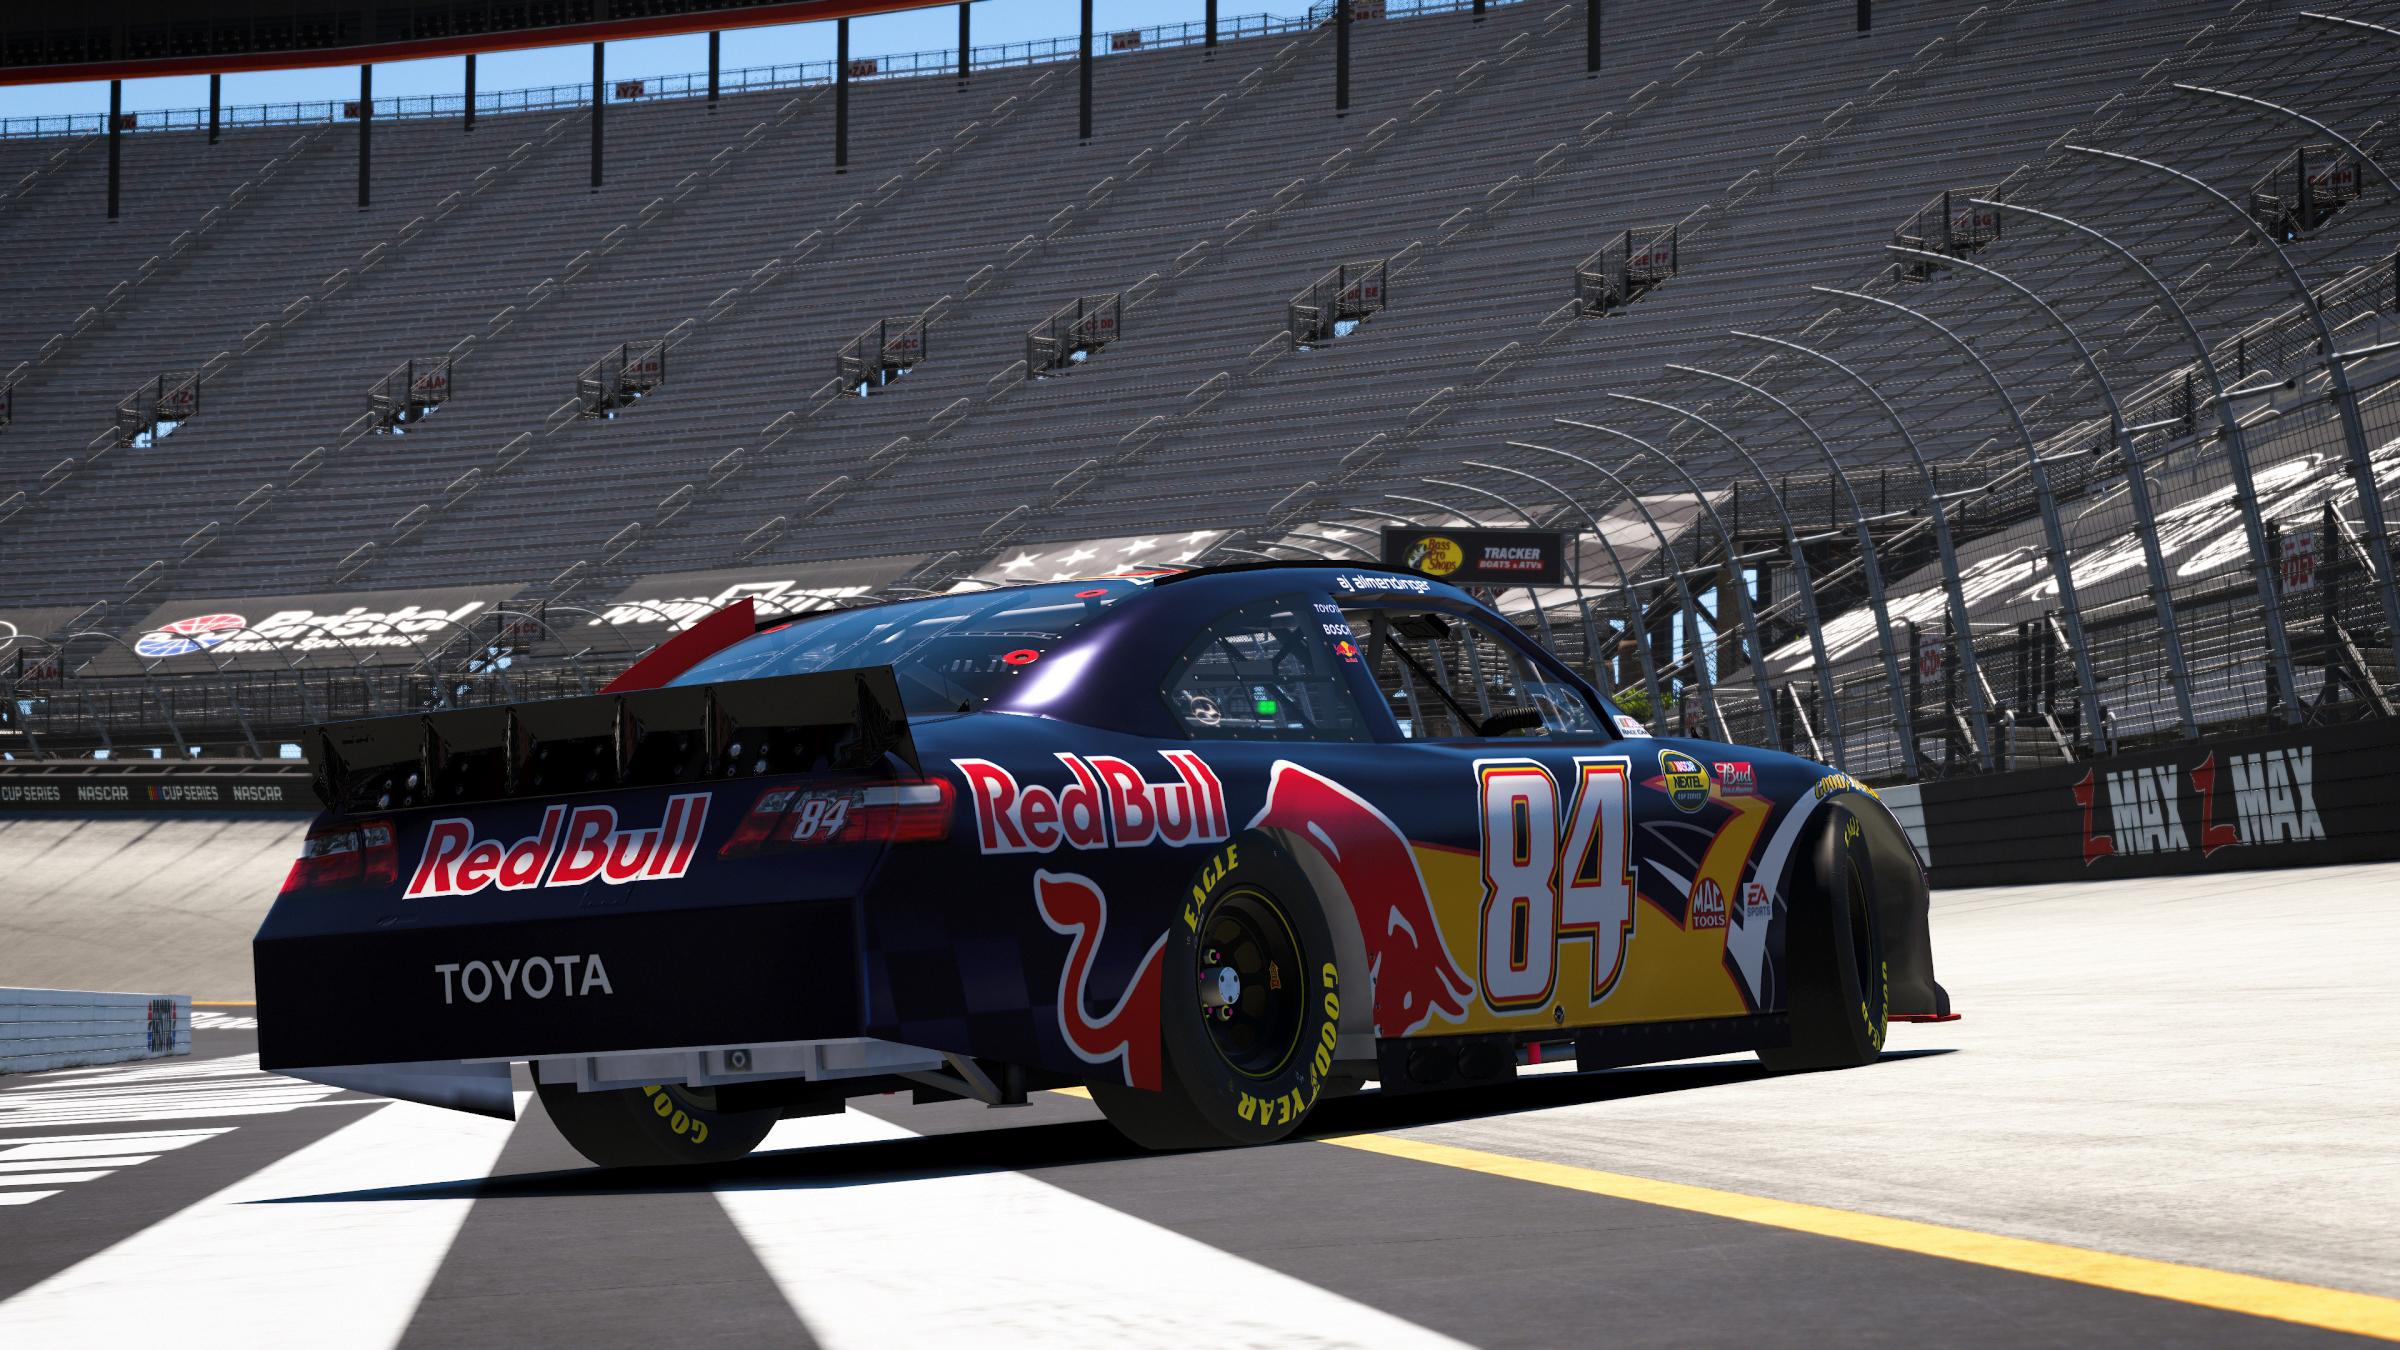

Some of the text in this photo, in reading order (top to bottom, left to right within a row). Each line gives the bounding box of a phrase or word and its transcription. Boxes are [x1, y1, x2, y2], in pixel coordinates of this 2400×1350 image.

[1428, 538, 1450, 550] Bass
[1429, 550, 1446, 560] Pro
[1484, 547, 1541, 559] TRACKER
[1429, 558, 1457, 572] Shops
[1479, 560, 1510, 569] BOATS
[1715, 762, 1751, 786] Bud
[1673, 775, 1704, 789] NEXTEL
[2, 786, 60, 801] CUP SERIES
[78, 786, 128, 801] NASCAR
[162, 786, 218, 801] CUP SERIES
[233, 786, 282, 801] NASCAR
[792, 799, 849, 841] 84
[1184, 844, 1239, 934] EAGLE
[1473, 756, 1638, 1018] 84
[1747, 884, 1769, 906] EA
[1693, 914, 1726, 927] TOOLS
[435, 954, 613, 1004] TOYOTA
